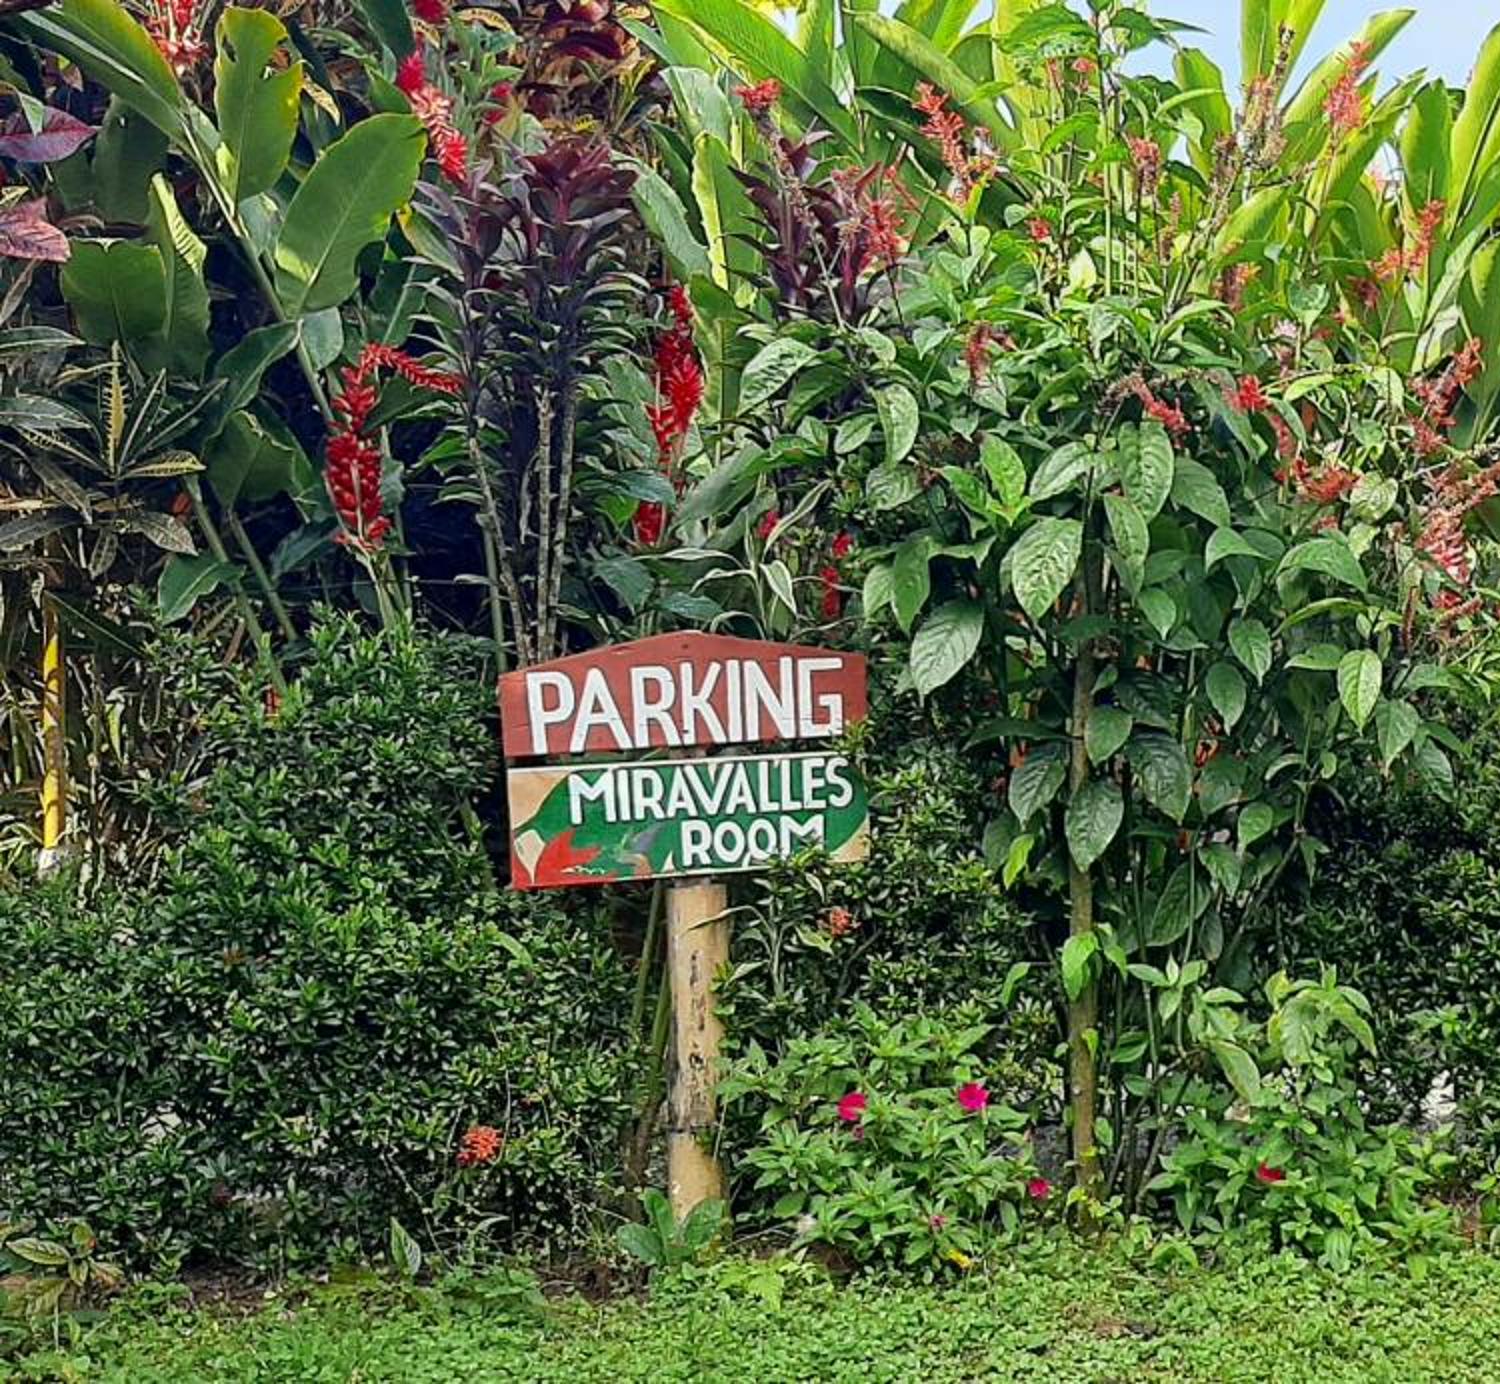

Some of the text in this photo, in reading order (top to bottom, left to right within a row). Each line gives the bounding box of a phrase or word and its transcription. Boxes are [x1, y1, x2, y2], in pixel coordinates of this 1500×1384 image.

[526, 656, 844, 754] PARKING
[568, 757, 854, 825] MIRAVALLES
[680, 814, 825, 868] ROOM
